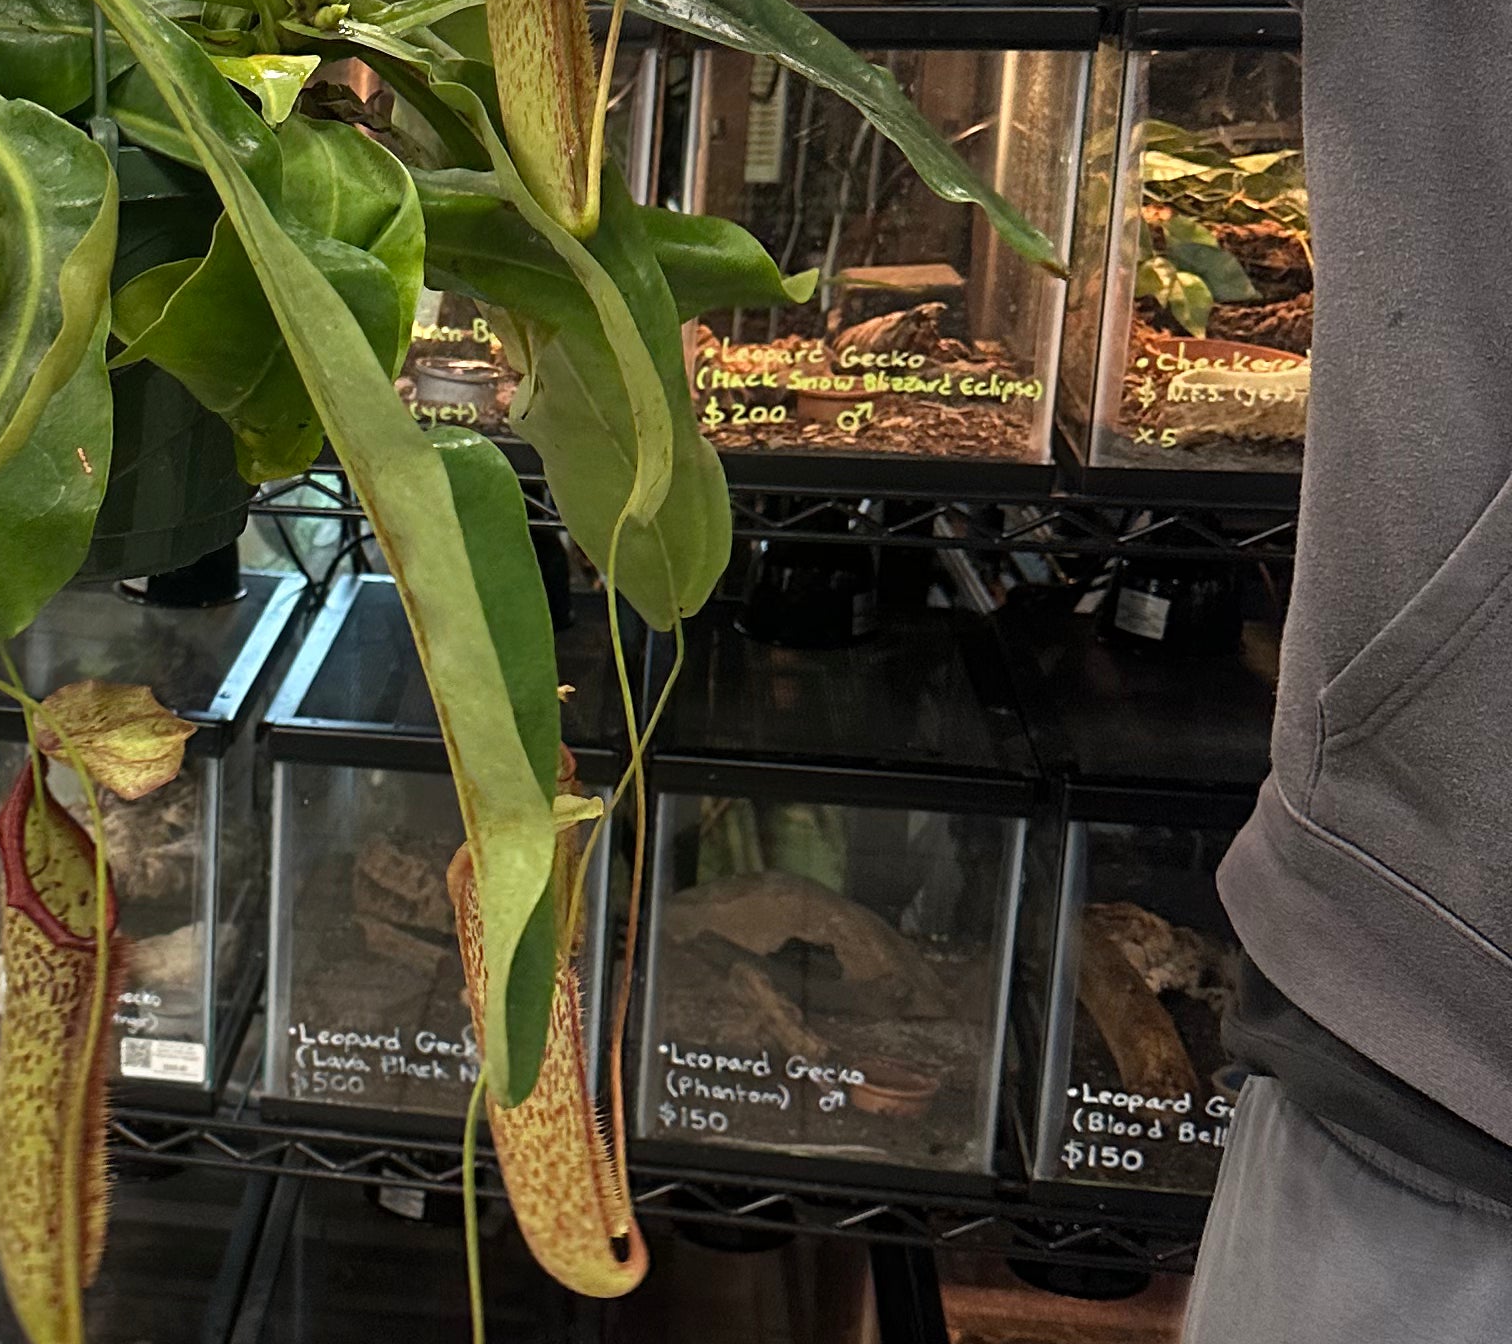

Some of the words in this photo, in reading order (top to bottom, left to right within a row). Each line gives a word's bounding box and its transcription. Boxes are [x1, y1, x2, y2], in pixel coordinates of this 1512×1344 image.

[722, 336, 826, 365] Leopard
[840, 344, 926, 369] Gecko
[1156, 341, 1312, 373] Checkere
[696, 370, 779, 391] (Mack
[788, 372, 855, 392] Snow
[862, 373, 953, 395] Blizzard
[959, 374, 1044, 402] Eclipse)
[409, 401, 478, 429] (yet)
[701, 396, 787, 430] $200
[298, 1021, 402, 1054] Leopard
[295, 1044, 372, 1074] (Lava
[671, 1041, 773, 1078] Leopard
[785, 1054, 867, 1086] Gecko
[290, 1069, 365, 1098] $500
[665, 1068, 792, 1111] (Phantom)
[1082, 1082, 1192, 1115] Leopard
[658, 1099, 729, 1134] $150
[1072, 1106, 1164, 1141] (Blood
[1061, 1137, 1145, 1174] $150
